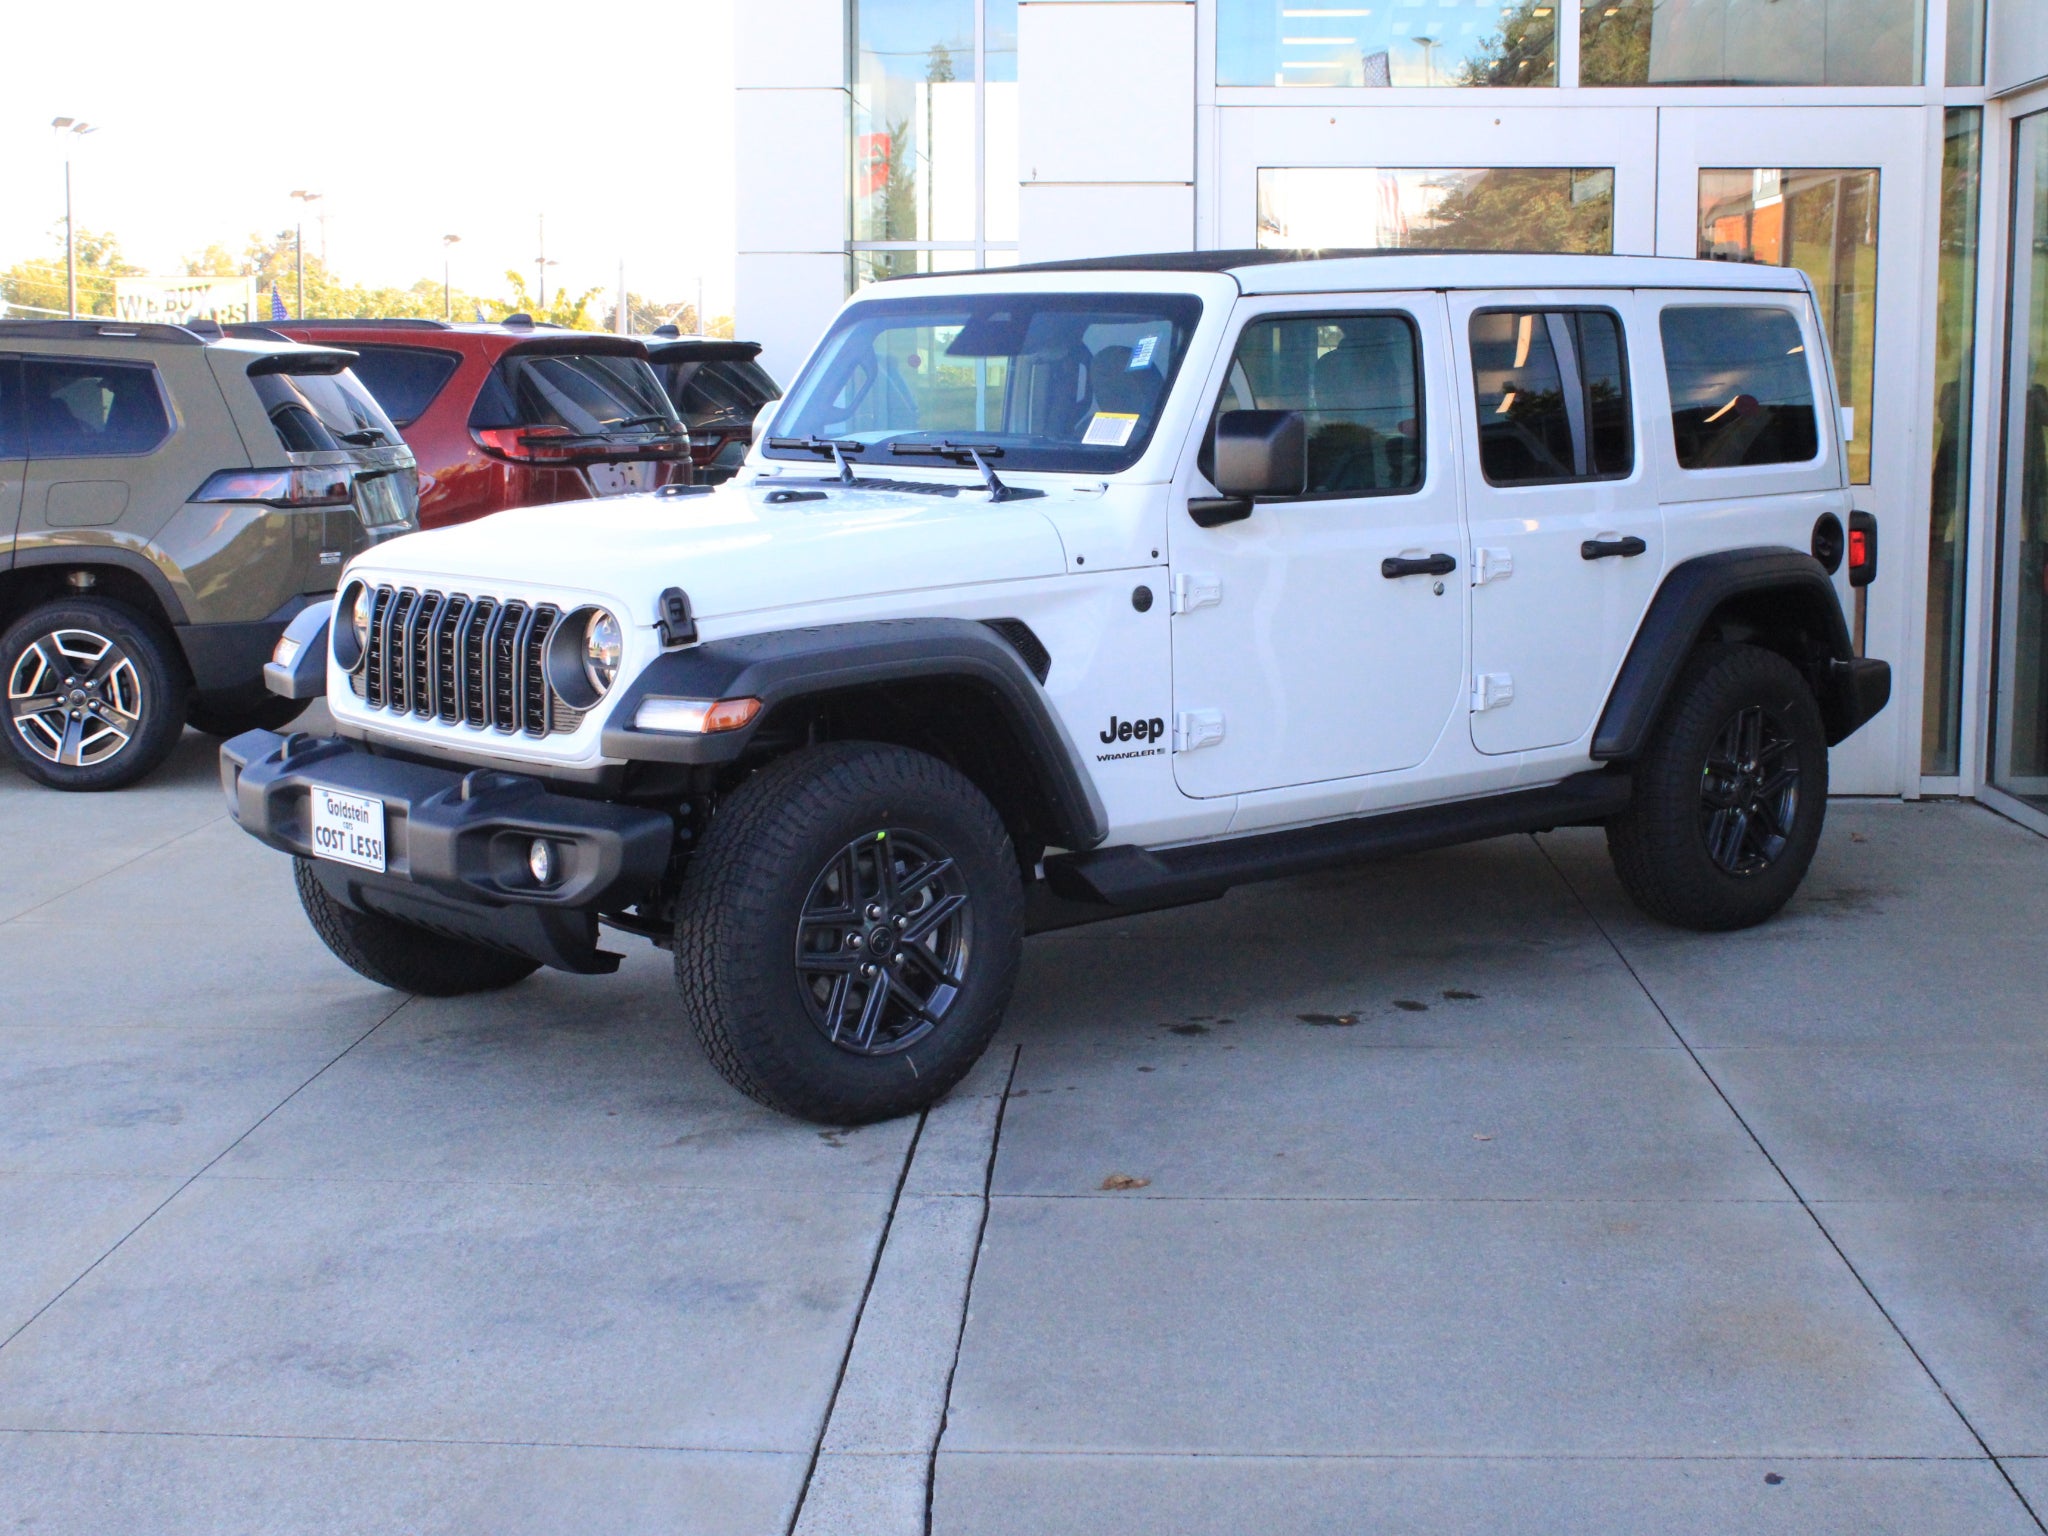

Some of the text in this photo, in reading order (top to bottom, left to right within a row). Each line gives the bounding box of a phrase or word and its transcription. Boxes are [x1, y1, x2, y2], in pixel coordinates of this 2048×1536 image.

[118, 294, 159, 321] WE
[163, 284, 212, 312] BUY
[1100, 715, 1164, 744] Jeep
[1096, 748, 1155, 762] WRANGLER
[327, 798, 369, 824] Goldstein
[315, 825, 382, 862] COST LESS!
